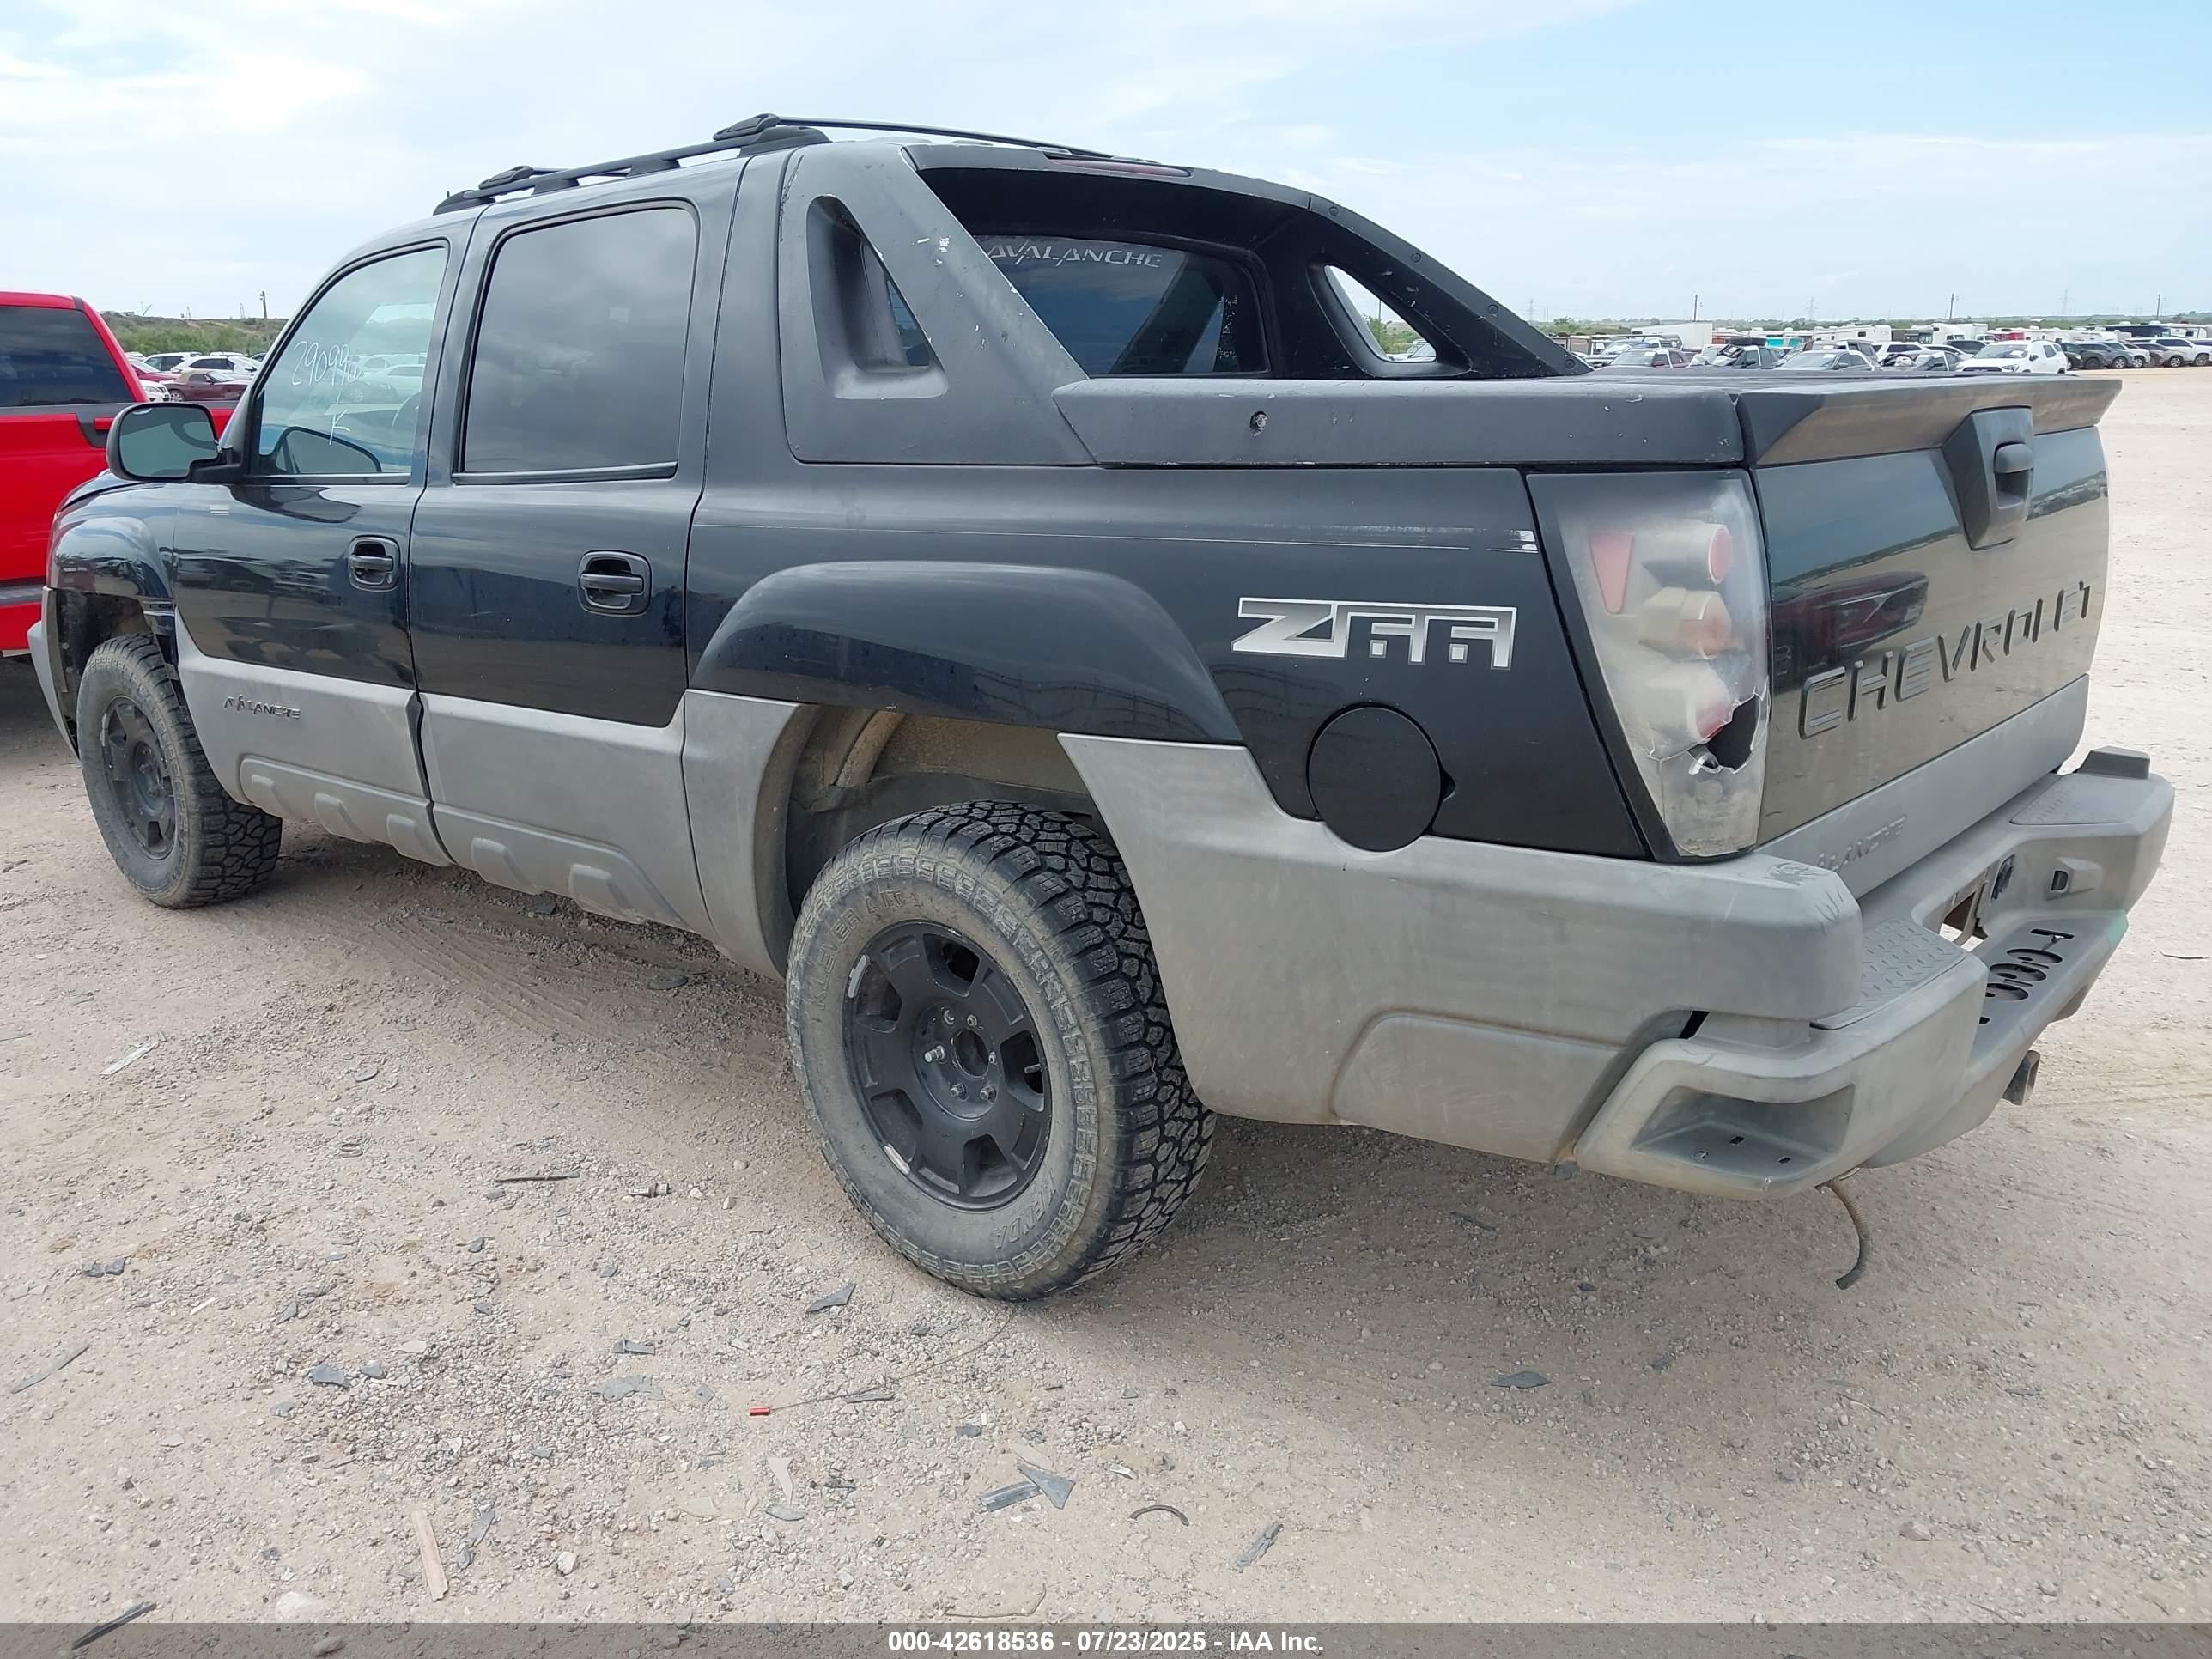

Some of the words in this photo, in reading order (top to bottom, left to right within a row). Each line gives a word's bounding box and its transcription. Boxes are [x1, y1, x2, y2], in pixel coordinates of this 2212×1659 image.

[988, 240, 1163, 268] AVALANCHE
[1798, 580, 2091, 740] CHEVROLET
[812, 907, 863, 1010] KLEVER
